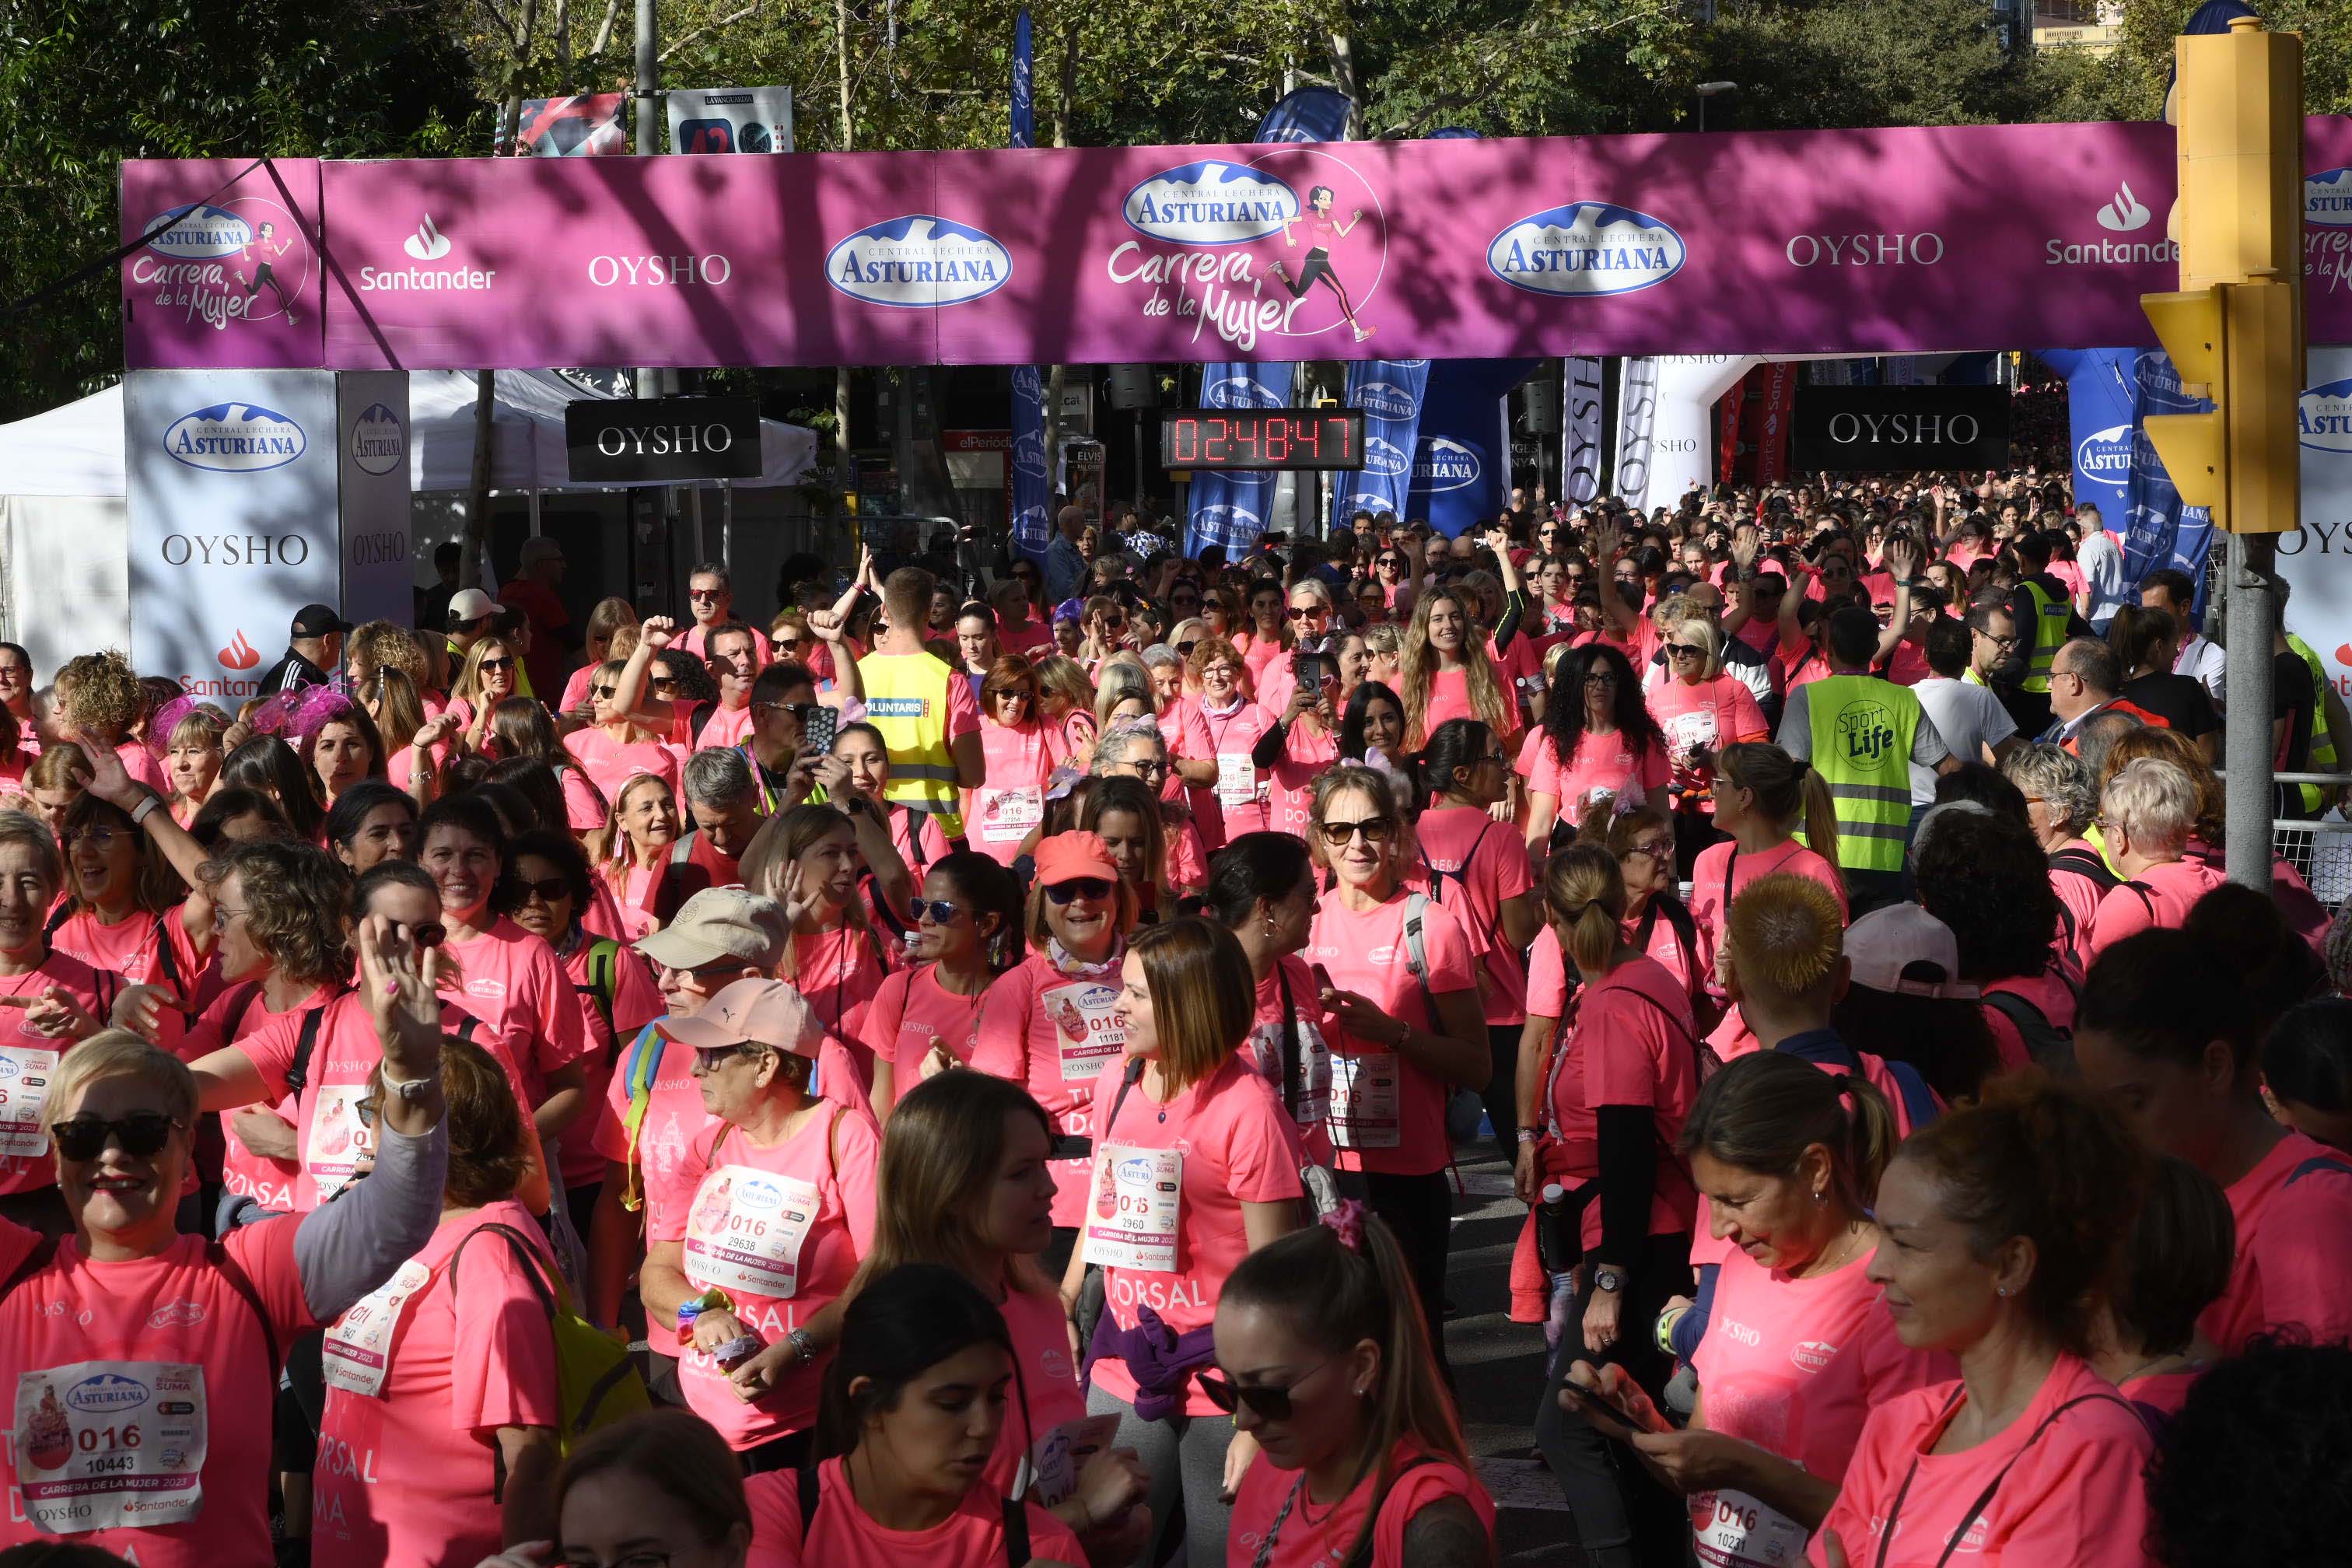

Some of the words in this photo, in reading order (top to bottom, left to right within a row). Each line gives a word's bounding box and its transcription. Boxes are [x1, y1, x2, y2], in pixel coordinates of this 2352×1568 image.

[1163, 189, 1220, 199] CENTRAL
[1224, 188, 1281, 198] LECHERA
[1136, 192, 1286, 225] ASTURIANA
[1533, 234, 1592, 244] CENTRAL
[1600, 233, 1664, 243] LECHERA
[868, 246, 927, 256] CENTRAL
[933, 246, 992, 256] LECHERA
[1503, 239, 1671, 273] ASTURIANA
[1787, 233, 1944, 267] OYSHO
[2046, 238, 2180, 264] Santande
[132, 255, 223, 285] Carrera
[587, 254, 731, 286] OYSHO
[840, 250, 998, 283] ASTURIANA
[1108, 240, 1254, 284] Carrera
[2319, 254, 2332, 275] la
[360, 266, 495, 292] Santander
[156, 286, 172, 306] de
[176, 285, 187, 306] la
[186, 282, 259, 331] Mujer
[1143, 286, 1171, 317] de
[1176, 285, 1195, 316] la
[1192, 280, 1307, 351] Mujer
[1768, 362, 1787, 411] Santa
[1353, 394, 1412, 417] ASTURIANA
[1570, 357, 1600, 508] OYSH
[1619, 357, 1655, 496] OYSH
[1829, 413, 1979, 444] OYSHO
[175, 428, 296, 455] ASTURIANA
[355, 430, 401, 459] ASTURIANA
[597, 423, 733, 456] OYSHO
[1175, 418, 1349, 460] 02:48:47
[1650, 439, 1696, 453] YSHO
[1077, 451, 1101, 461] ELVIS
[1366, 453, 1402, 471] URIANA
[1762, 439, 1775, 482] ports
[2083, 447, 2132, 471] ASTU
[1411, 464, 1473, 478] URIANA
[161, 534, 309, 565] OYSHO
[353, 530, 404, 566] OYSHO
[180, 674, 261, 697] Santan
[866, 702, 921, 712] OLUNTARIS
[1839, 706, 1885, 733] Sport
[1849, 725, 1894, 759] Life
[1002, 807, 1022, 815] 016
[1431, 859, 1462, 872] RERA
[1704, 882, 1726, 891] OYSH
[1307, 945, 1339, 958] YSHO
[1090, 1015, 1125, 1031] 016
[1098, 1033, 1125, 1043] 11181
[1073, 1048, 1102, 1057] CARRERA
[23, 1063, 47, 1072] SUMA
[324, 1060, 372, 1073] OYSHO
[1071, 1062, 1105, 1073] OYSHO
[1330, 1089, 1362, 1103] 016
[0, 1137, 38, 1147] Santander
[319, 1181, 345, 1190] OYSH
[787, 1195, 811, 1206] SUMA
[731, 1214, 767, 1237] 016
[1097, 1230, 1124, 1240] CARRERA
[727, 1236, 757, 1251] 29638
[1093, 1244, 1123, 1258] OYSHO
[726, 1251, 735, 1260] DE
[735, 1253, 744, 1262] LA
[744, 1255, 767, 1268] MUJER
[768, 1262, 785, 1272] 2023
[1144, 1252, 1173, 1262] Santand
[747, 1274, 786, 1290] Santander
[1111, 1279, 1207, 1311] DORSAL
[1720, 1317, 1761, 1347] YSHO
[359, 1353, 374, 1363] 2023
[338, 1367, 375, 1384] Santander
[156, 1382, 191, 1391] SUMA
[72, 1390, 144, 1406] ASTURIANA
[78, 1424, 142, 1453] 016
[86, 1456, 134, 1474] 10443
[40, 1481, 89, 1495] CARRERA
[94, 1481, 107, 1489] DE
[110, 1479, 124, 1488] LA
[126, 1479, 159, 1488] MUJER
[163, 1478, 187, 1487] 2023
[37, 1504, 93, 1522] OYSHO
[134, 1497, 191, 1512] Santander
[313, 1491, 347, 1528] MA
[1718, 1500, 1758, 1531] 016
[1717, 1531, 1747, 1552] 10231
[1717, 1556, 1726, 1565] DE
